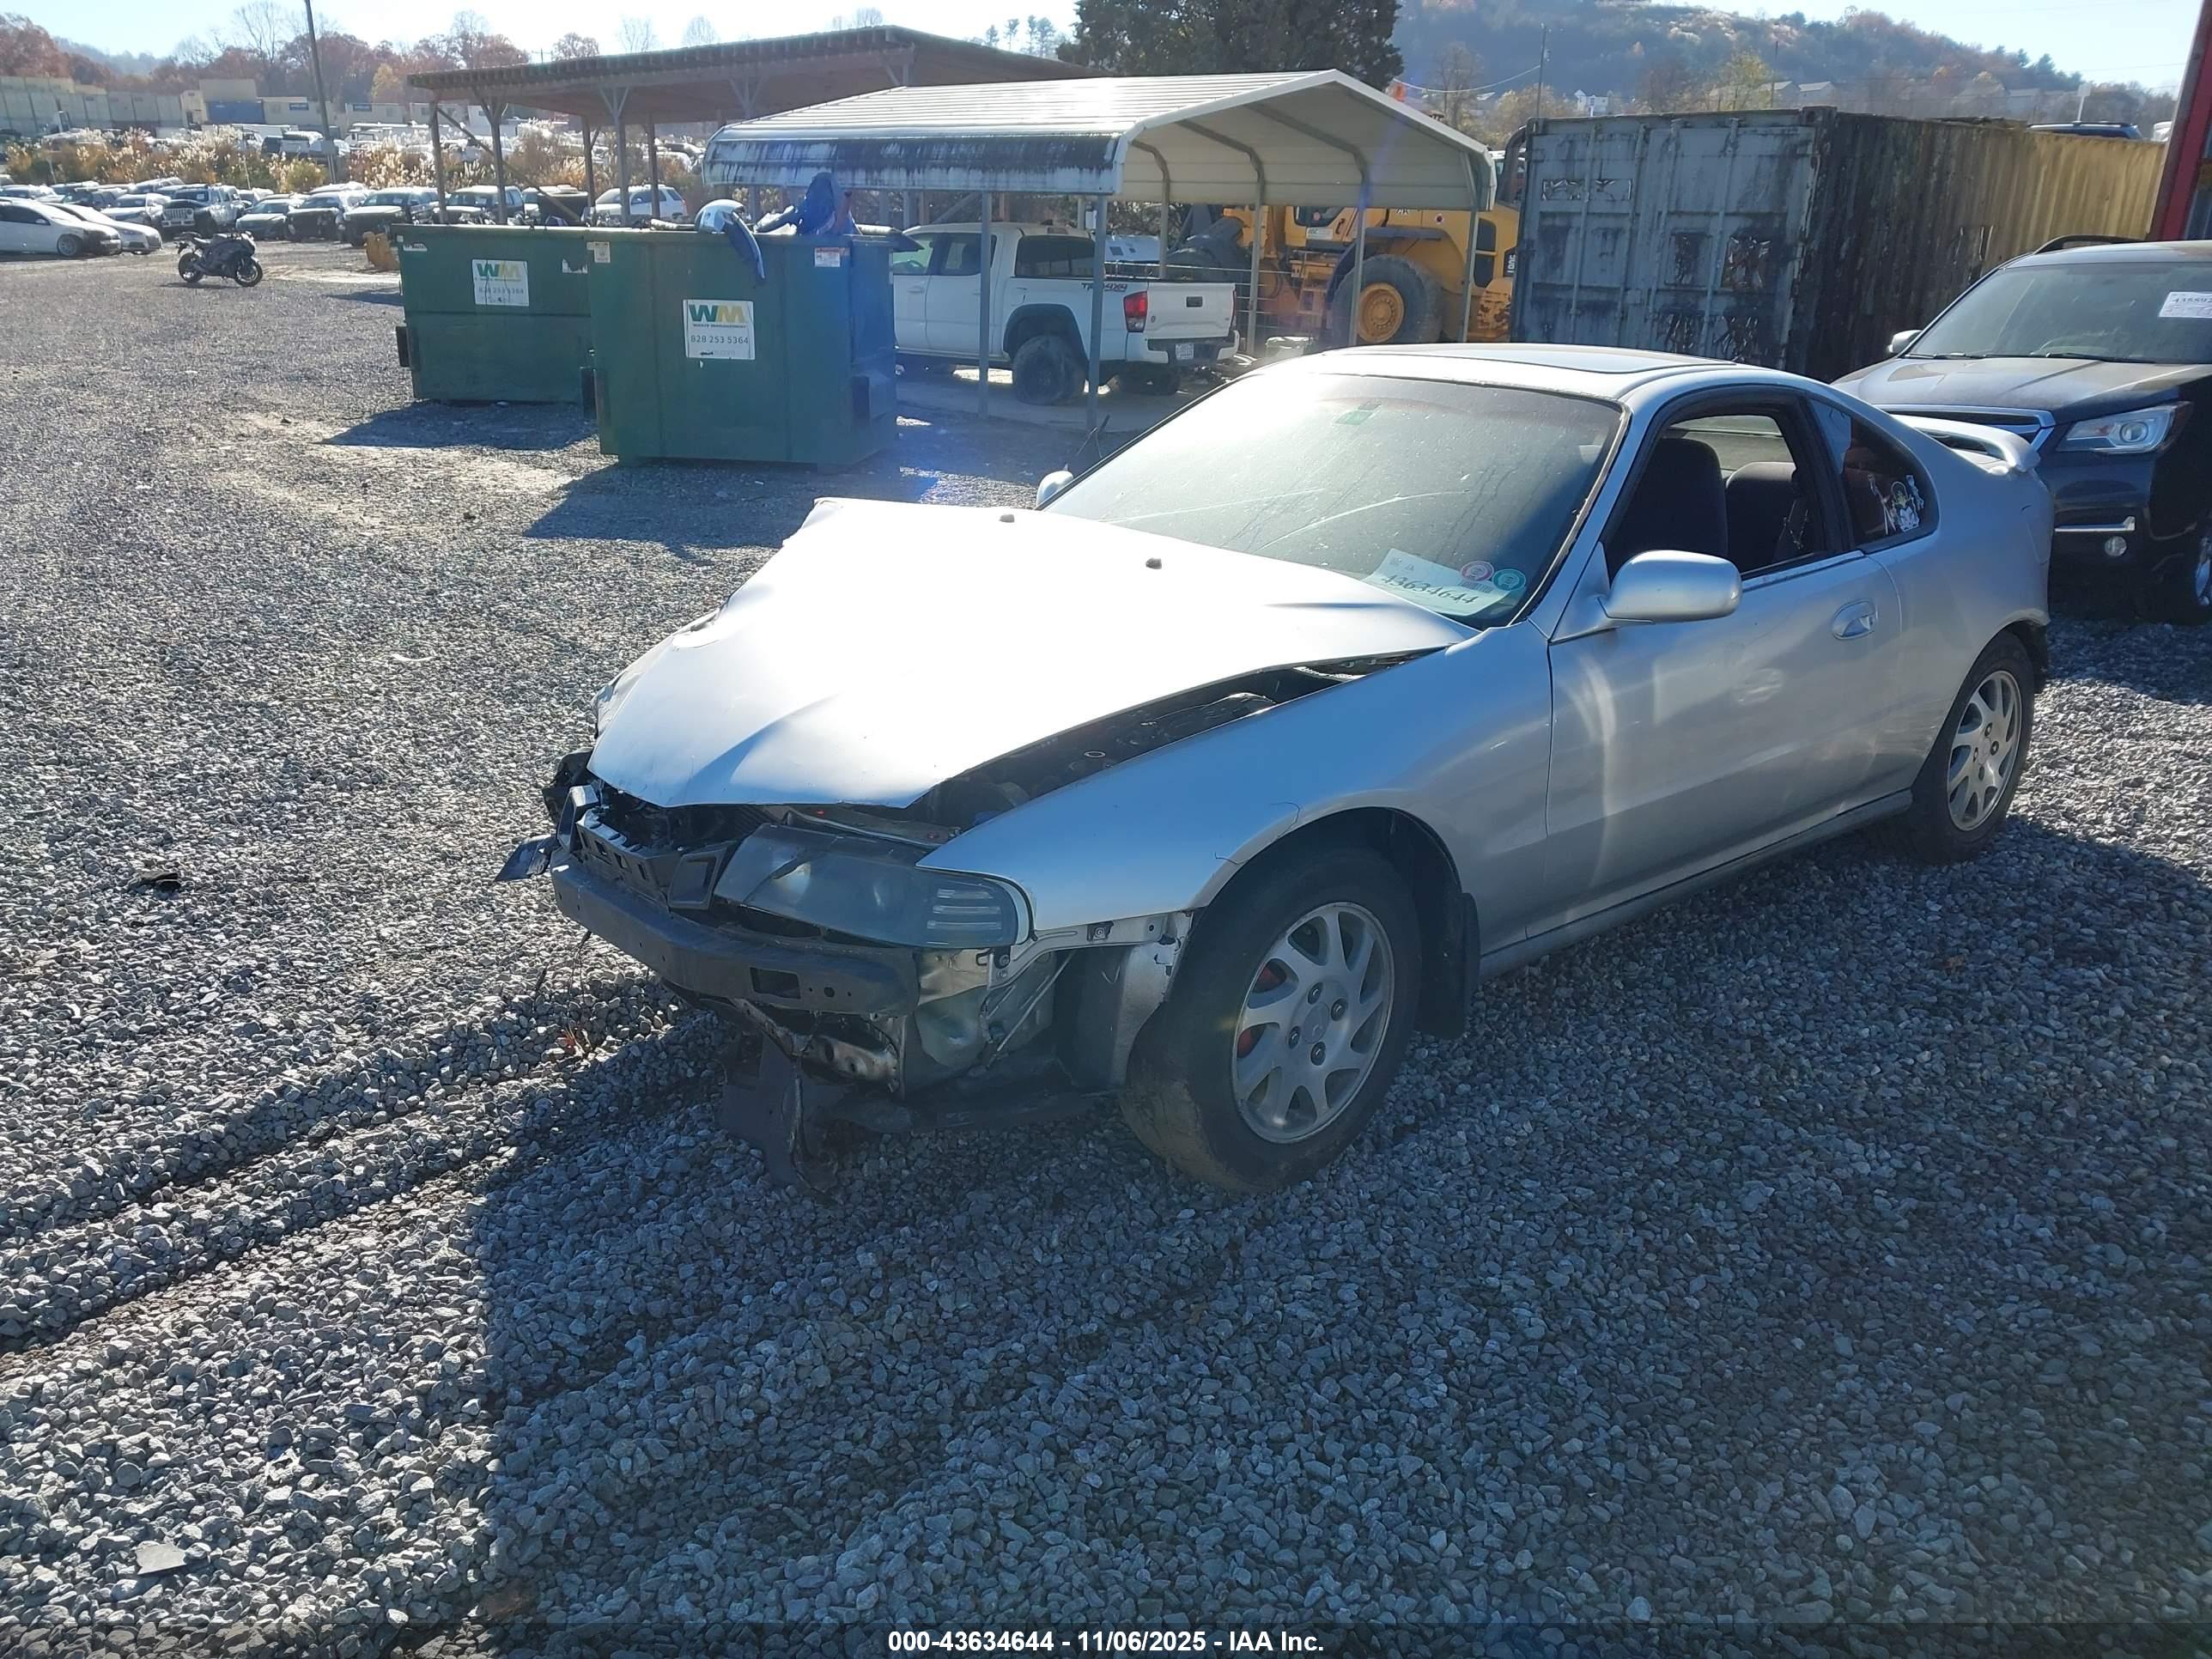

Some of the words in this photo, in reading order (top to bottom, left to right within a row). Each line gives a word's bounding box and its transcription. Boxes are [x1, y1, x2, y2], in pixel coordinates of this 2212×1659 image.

[689, 304, 745, 323] WM
[690, 335, 707, 343] 828
[709, 336, 725, 344] 253
[727, 336, 749, 344] 5364
[1382, 574, 1479, 605] 43634644
